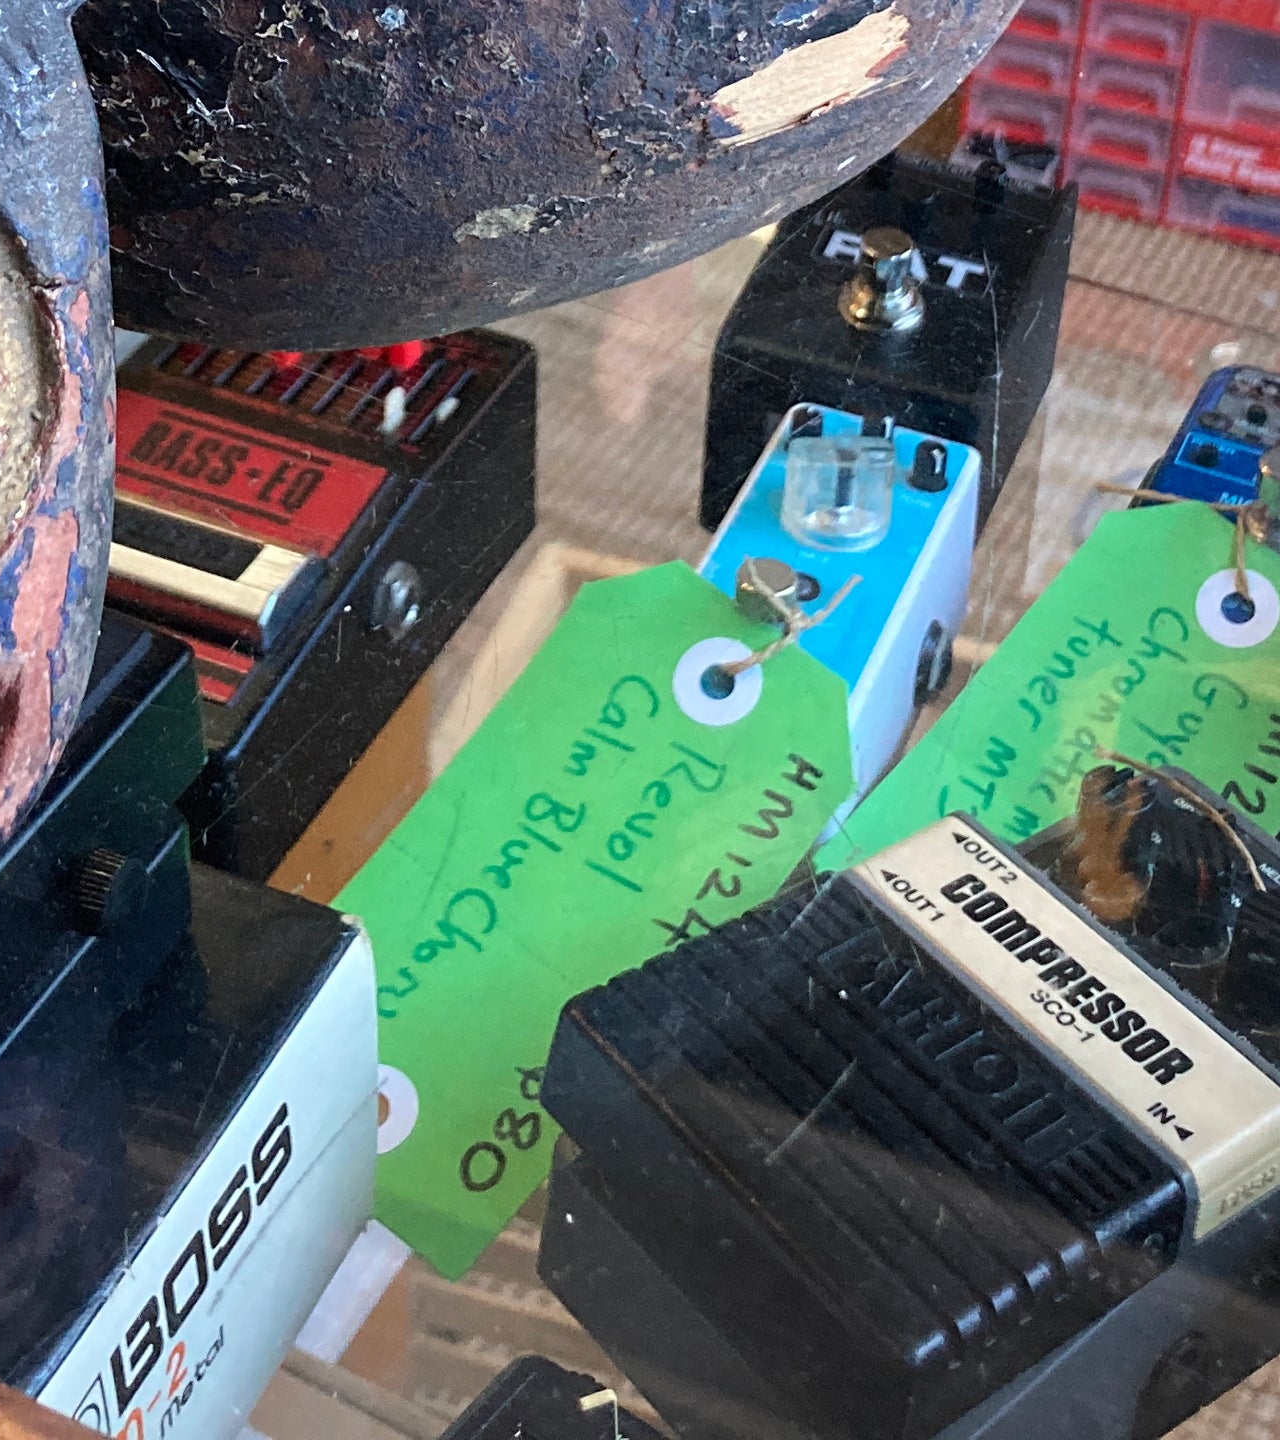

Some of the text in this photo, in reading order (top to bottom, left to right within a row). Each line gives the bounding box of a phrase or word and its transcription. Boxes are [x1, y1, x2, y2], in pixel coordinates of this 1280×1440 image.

[940, 873, 1195, 1086] COMPRESSOR
[1029, 988, 1096, 1044] SCO-1
[1146, 1101, 1177, 1127] IN
[110, 1103, 294, 1416] BOSS
